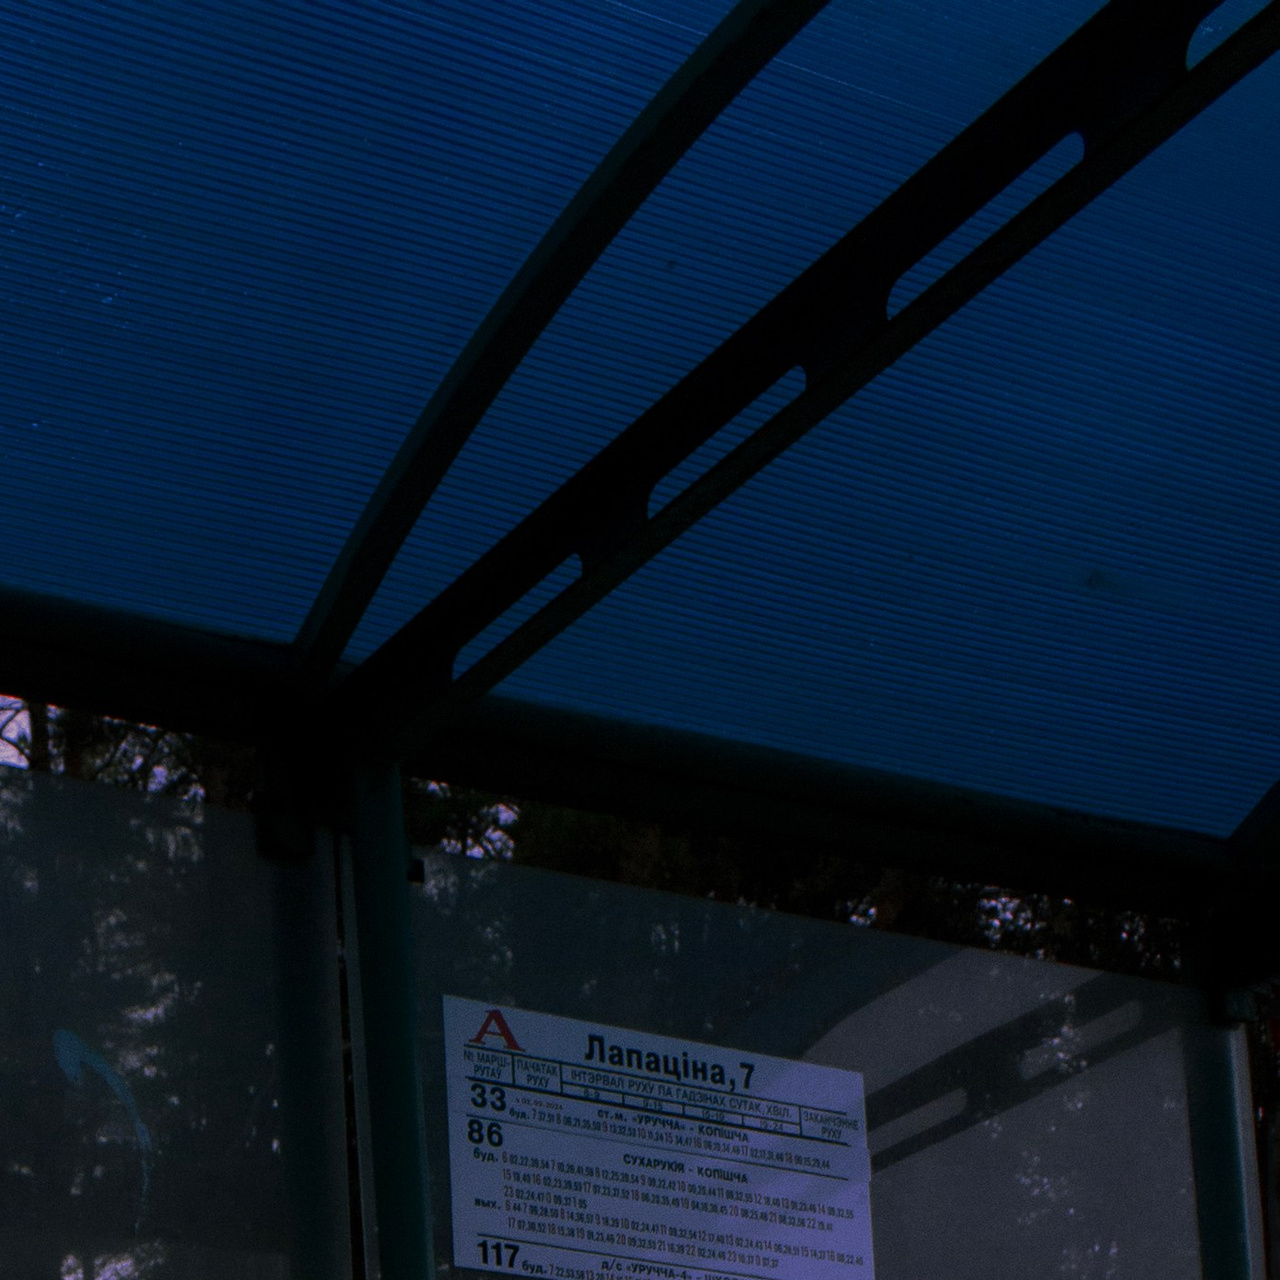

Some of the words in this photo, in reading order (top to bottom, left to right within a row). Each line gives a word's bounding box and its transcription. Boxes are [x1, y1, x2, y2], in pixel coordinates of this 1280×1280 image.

[517, 1059, 557, 1076] ПАЧАТАК
[526, 1073, 549, 1088] РУХУ
[628, 1078, 654, 1094] РУХУ
[657, 1084, 672, 1097] ПА
[471, 1083, 506, 1111] 33
[509, 1107, 529, 1120] буд.
[468, 1118, 503, 1147] 86
[698, 1124, 748, 1143] КОПІШЧА
[473, 1147, 498, 1164] буд.
[697, 1165, 747, 1184] КОПІШЧА
[474, 1197, 500, 1210] вых.
[478, 1240, 519, 1268] 117
[522, 1259, 547, 1276] буд.
